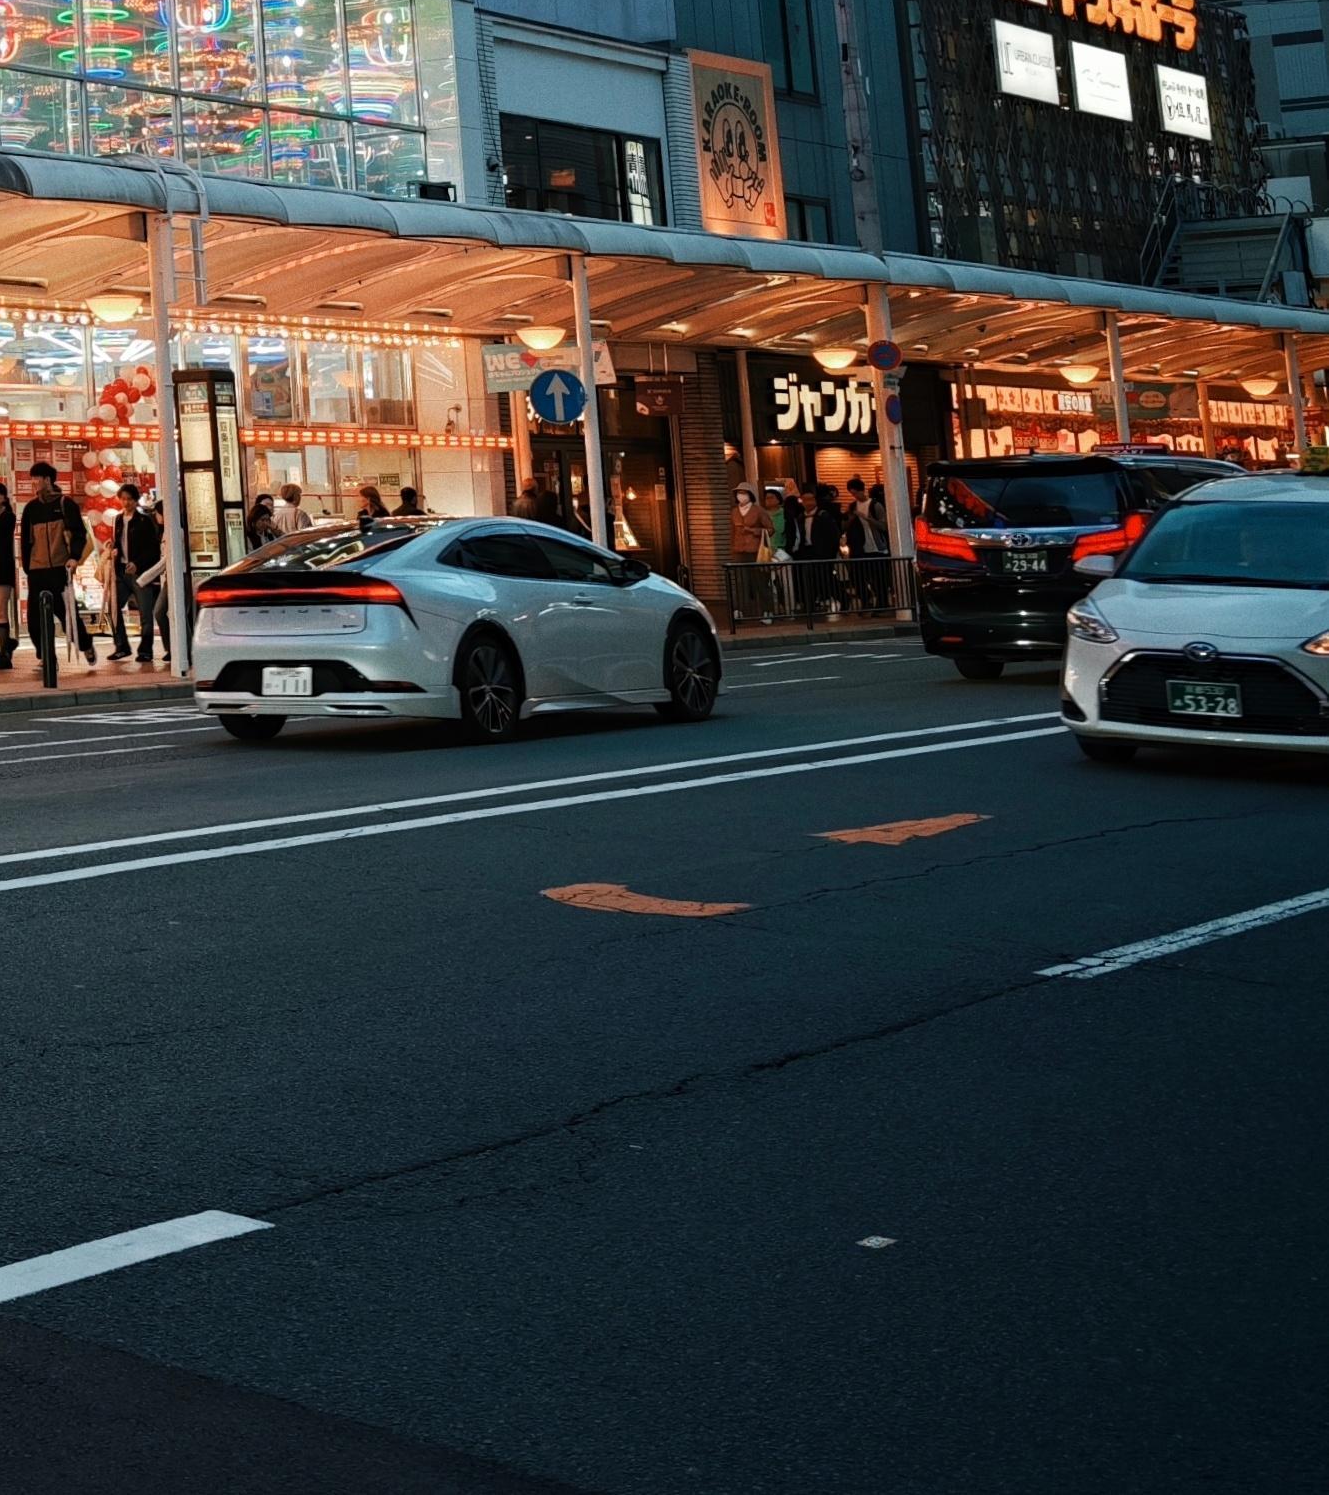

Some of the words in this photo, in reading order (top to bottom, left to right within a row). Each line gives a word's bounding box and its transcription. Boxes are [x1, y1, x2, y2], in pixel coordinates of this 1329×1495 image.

[774, 373, 877, 434] ジャンカ
[1012, 559, 1047, 572] 29-44
[1183, 695, 1239, 715] 53-28
